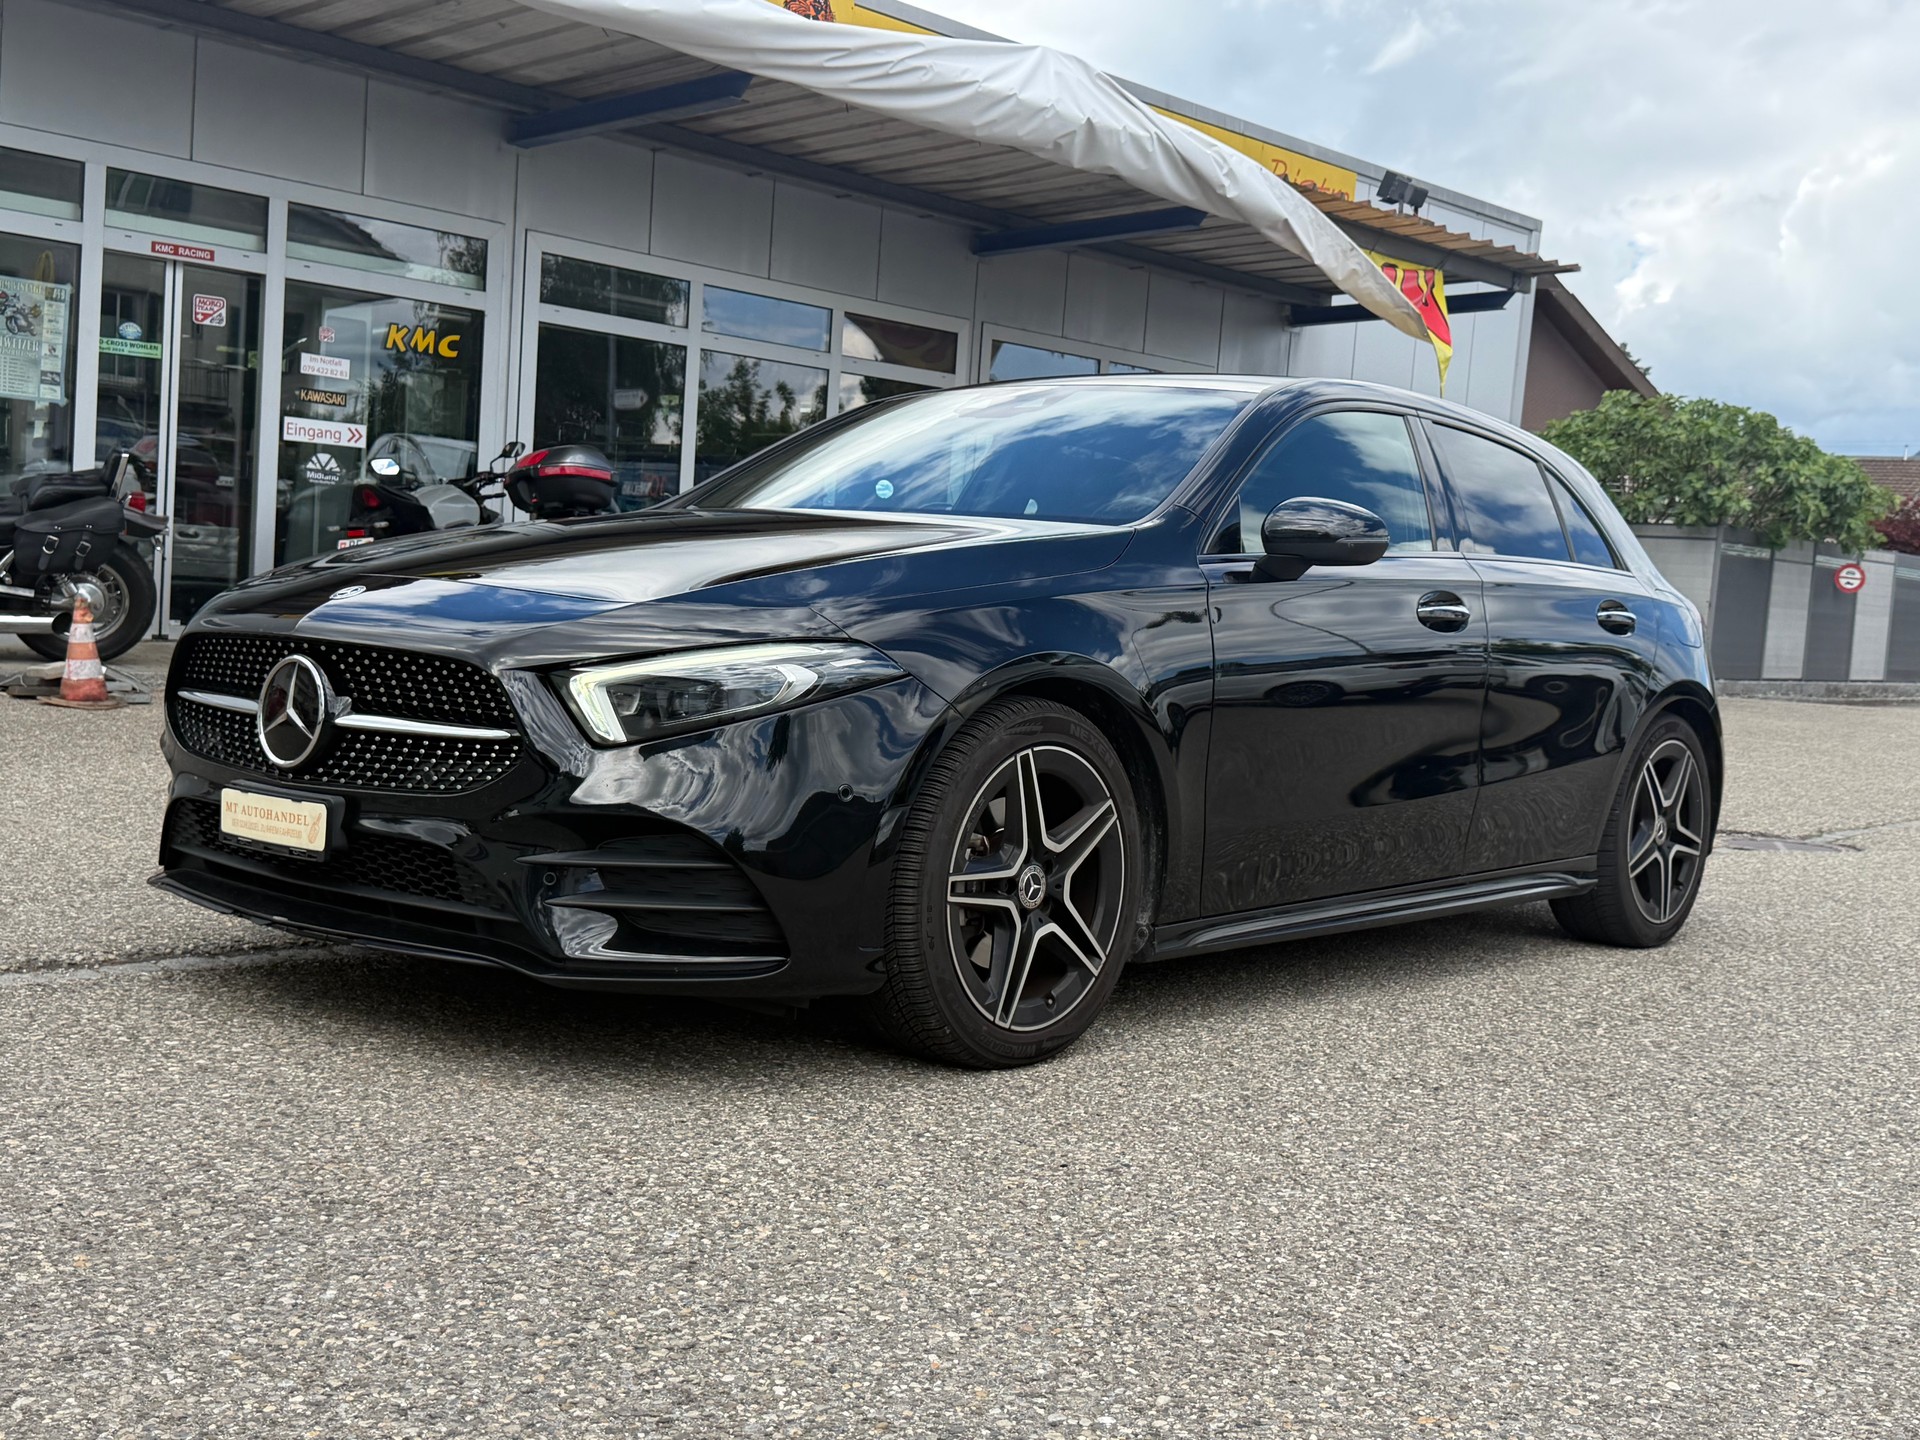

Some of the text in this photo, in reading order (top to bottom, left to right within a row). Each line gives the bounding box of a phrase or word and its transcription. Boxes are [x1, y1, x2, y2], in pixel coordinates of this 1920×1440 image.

[155, 243, 211, 259] KMC RACING
[129, 342, 159, 352] WOHLEN
[385, 323, 461, 358] KMC
[320, 357, 343, 366] Notfall
[300, 388, 346, 406] KAWASAKI
[286, 421, 342, 443] Eingang
[1069, 723, 1114, 768] NEXEN
[225, 801, 310, 826] MT AUTOHANDEL
[975, 1033, 1037, 1058] WINGUARD
